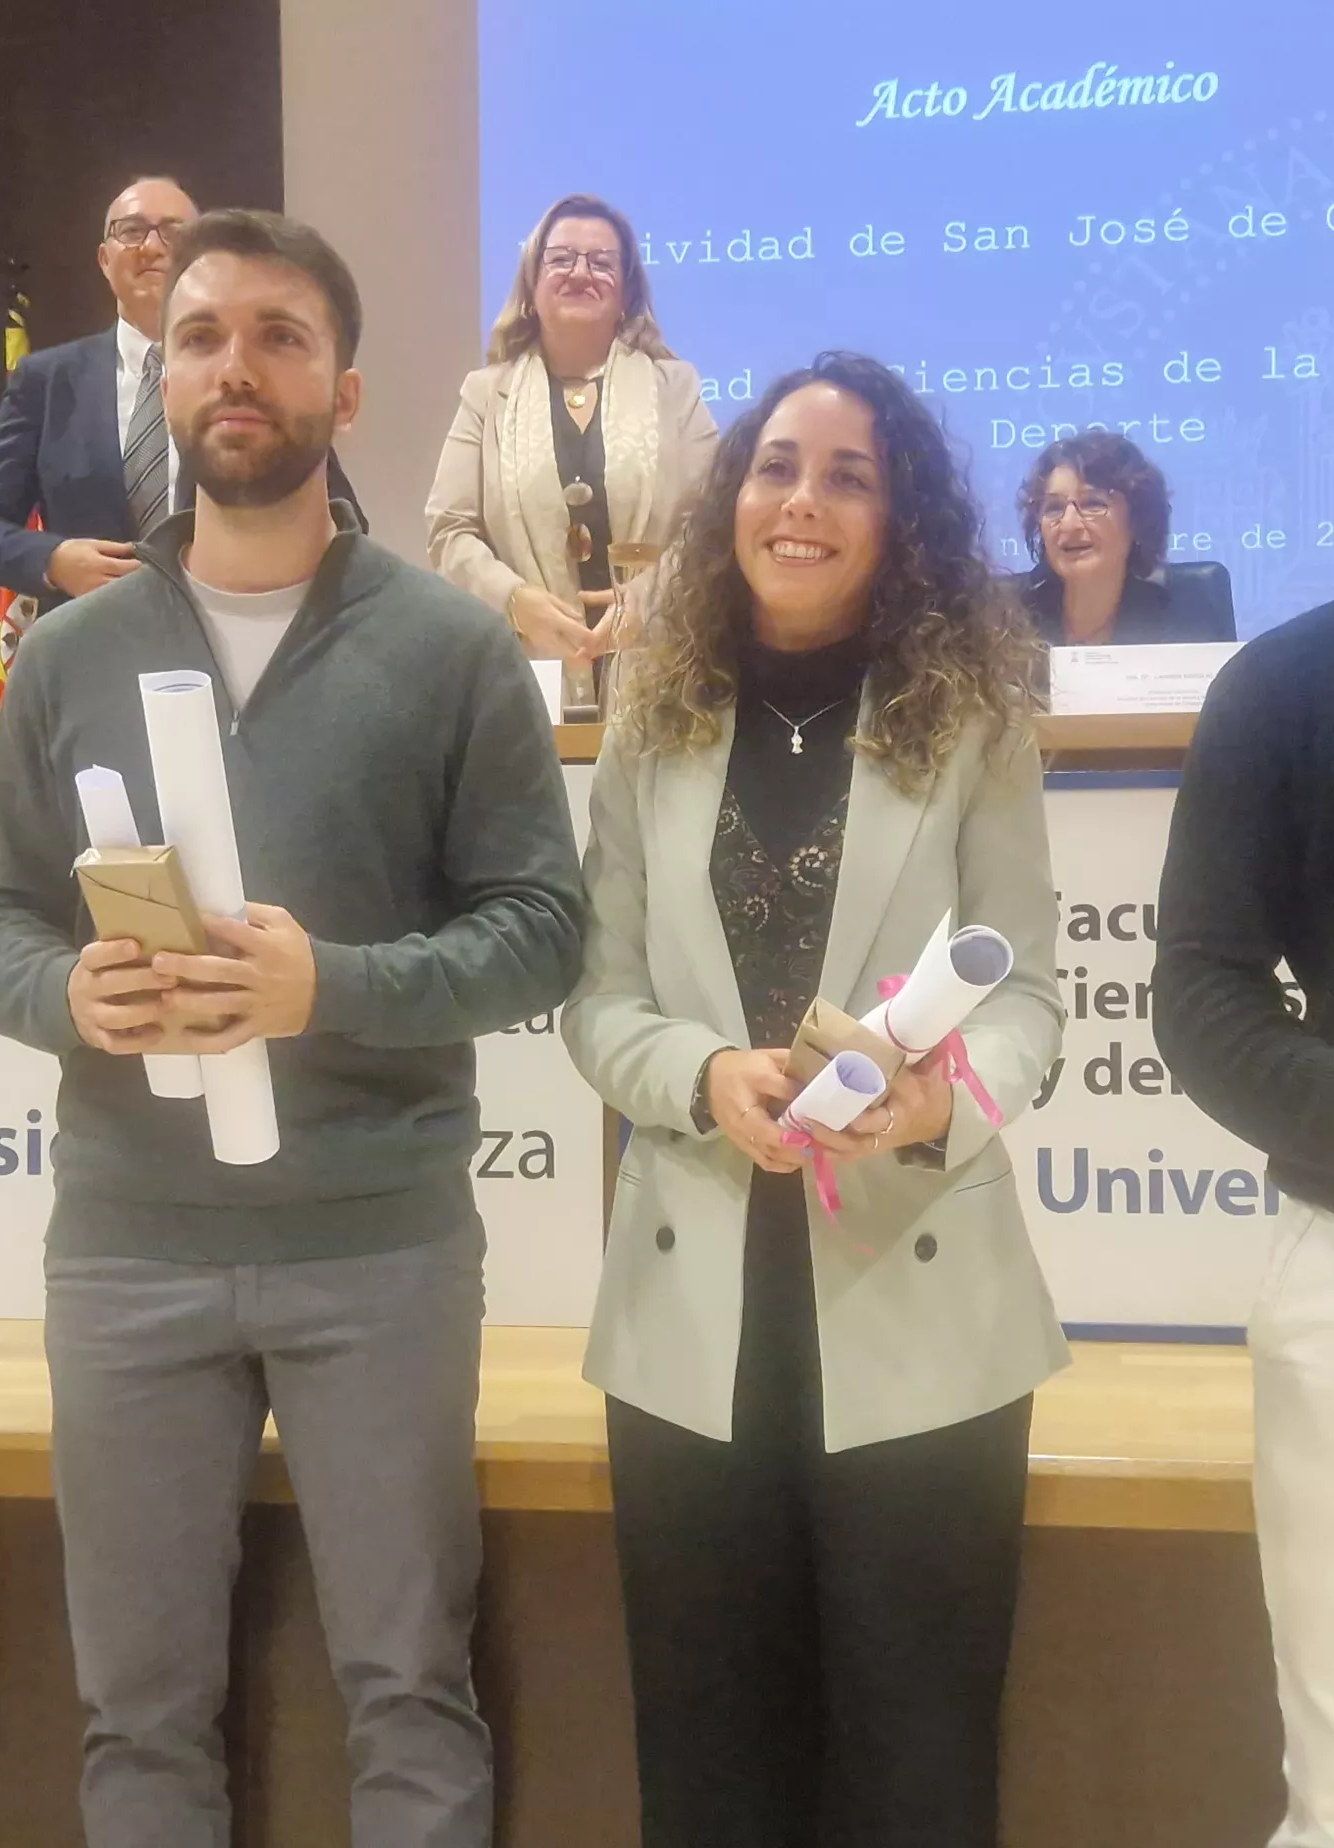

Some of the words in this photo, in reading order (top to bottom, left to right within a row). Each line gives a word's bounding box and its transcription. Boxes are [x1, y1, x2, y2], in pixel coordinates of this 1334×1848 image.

[856, 77, 967, 127] Acto
[972, 61, 1219, 121] Académico
[850, 224, 905, 257] de
[942, 220, 1031, 253] San
[1069, 207, 1190, 247] José
[1228, 205, 1288, 239] de
[891, 355, 1126, 393] iencias
[1164, 351, 1223, 384] de
[1263, 347, 1320, 379] la
[1241, 522, 1287, 550] de
